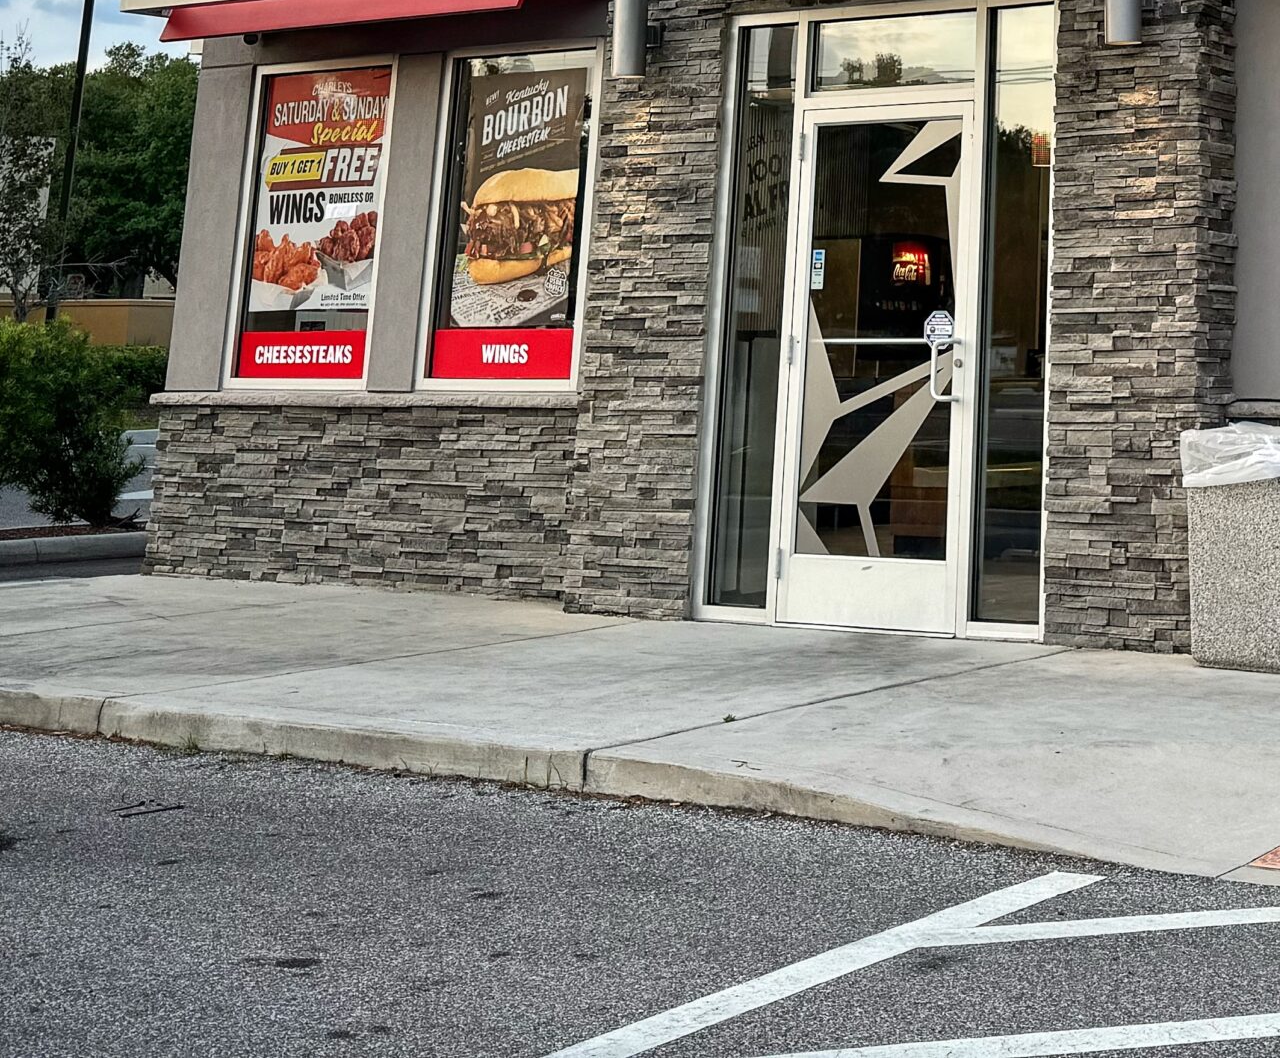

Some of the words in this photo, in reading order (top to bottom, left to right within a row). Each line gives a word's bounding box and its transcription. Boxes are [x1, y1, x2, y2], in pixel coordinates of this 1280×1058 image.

[312, 82, 353, 96] CHARLEYS
[505, 79, 549, 104] Kentucky
[275, 100, 331, 127] SATURDAY
[331, 99, 341, 121] &
[342, 96, 389, 122] SUNDAY
[482, 85, 569, 146] BOURBON
[311, 121, 377, 145] Special
[496, 126, 551, 158] CHEESESTEAK
[270, 162, 289, 175] BUY
[290, 160, 297, 173] 1
[297, 160, 315, 173] GET
[316, 158, 322, 172] 1
[321, 147, 380, 183] FREE
[269, 192, 325, 224] WINGS
[329, 193, 364, 204] BONELESS
[365, 192, 374, 203] OR
[255, 345, 353, 364] CHEESESTEAKS
[481, 344, 529, 364] WINGS
